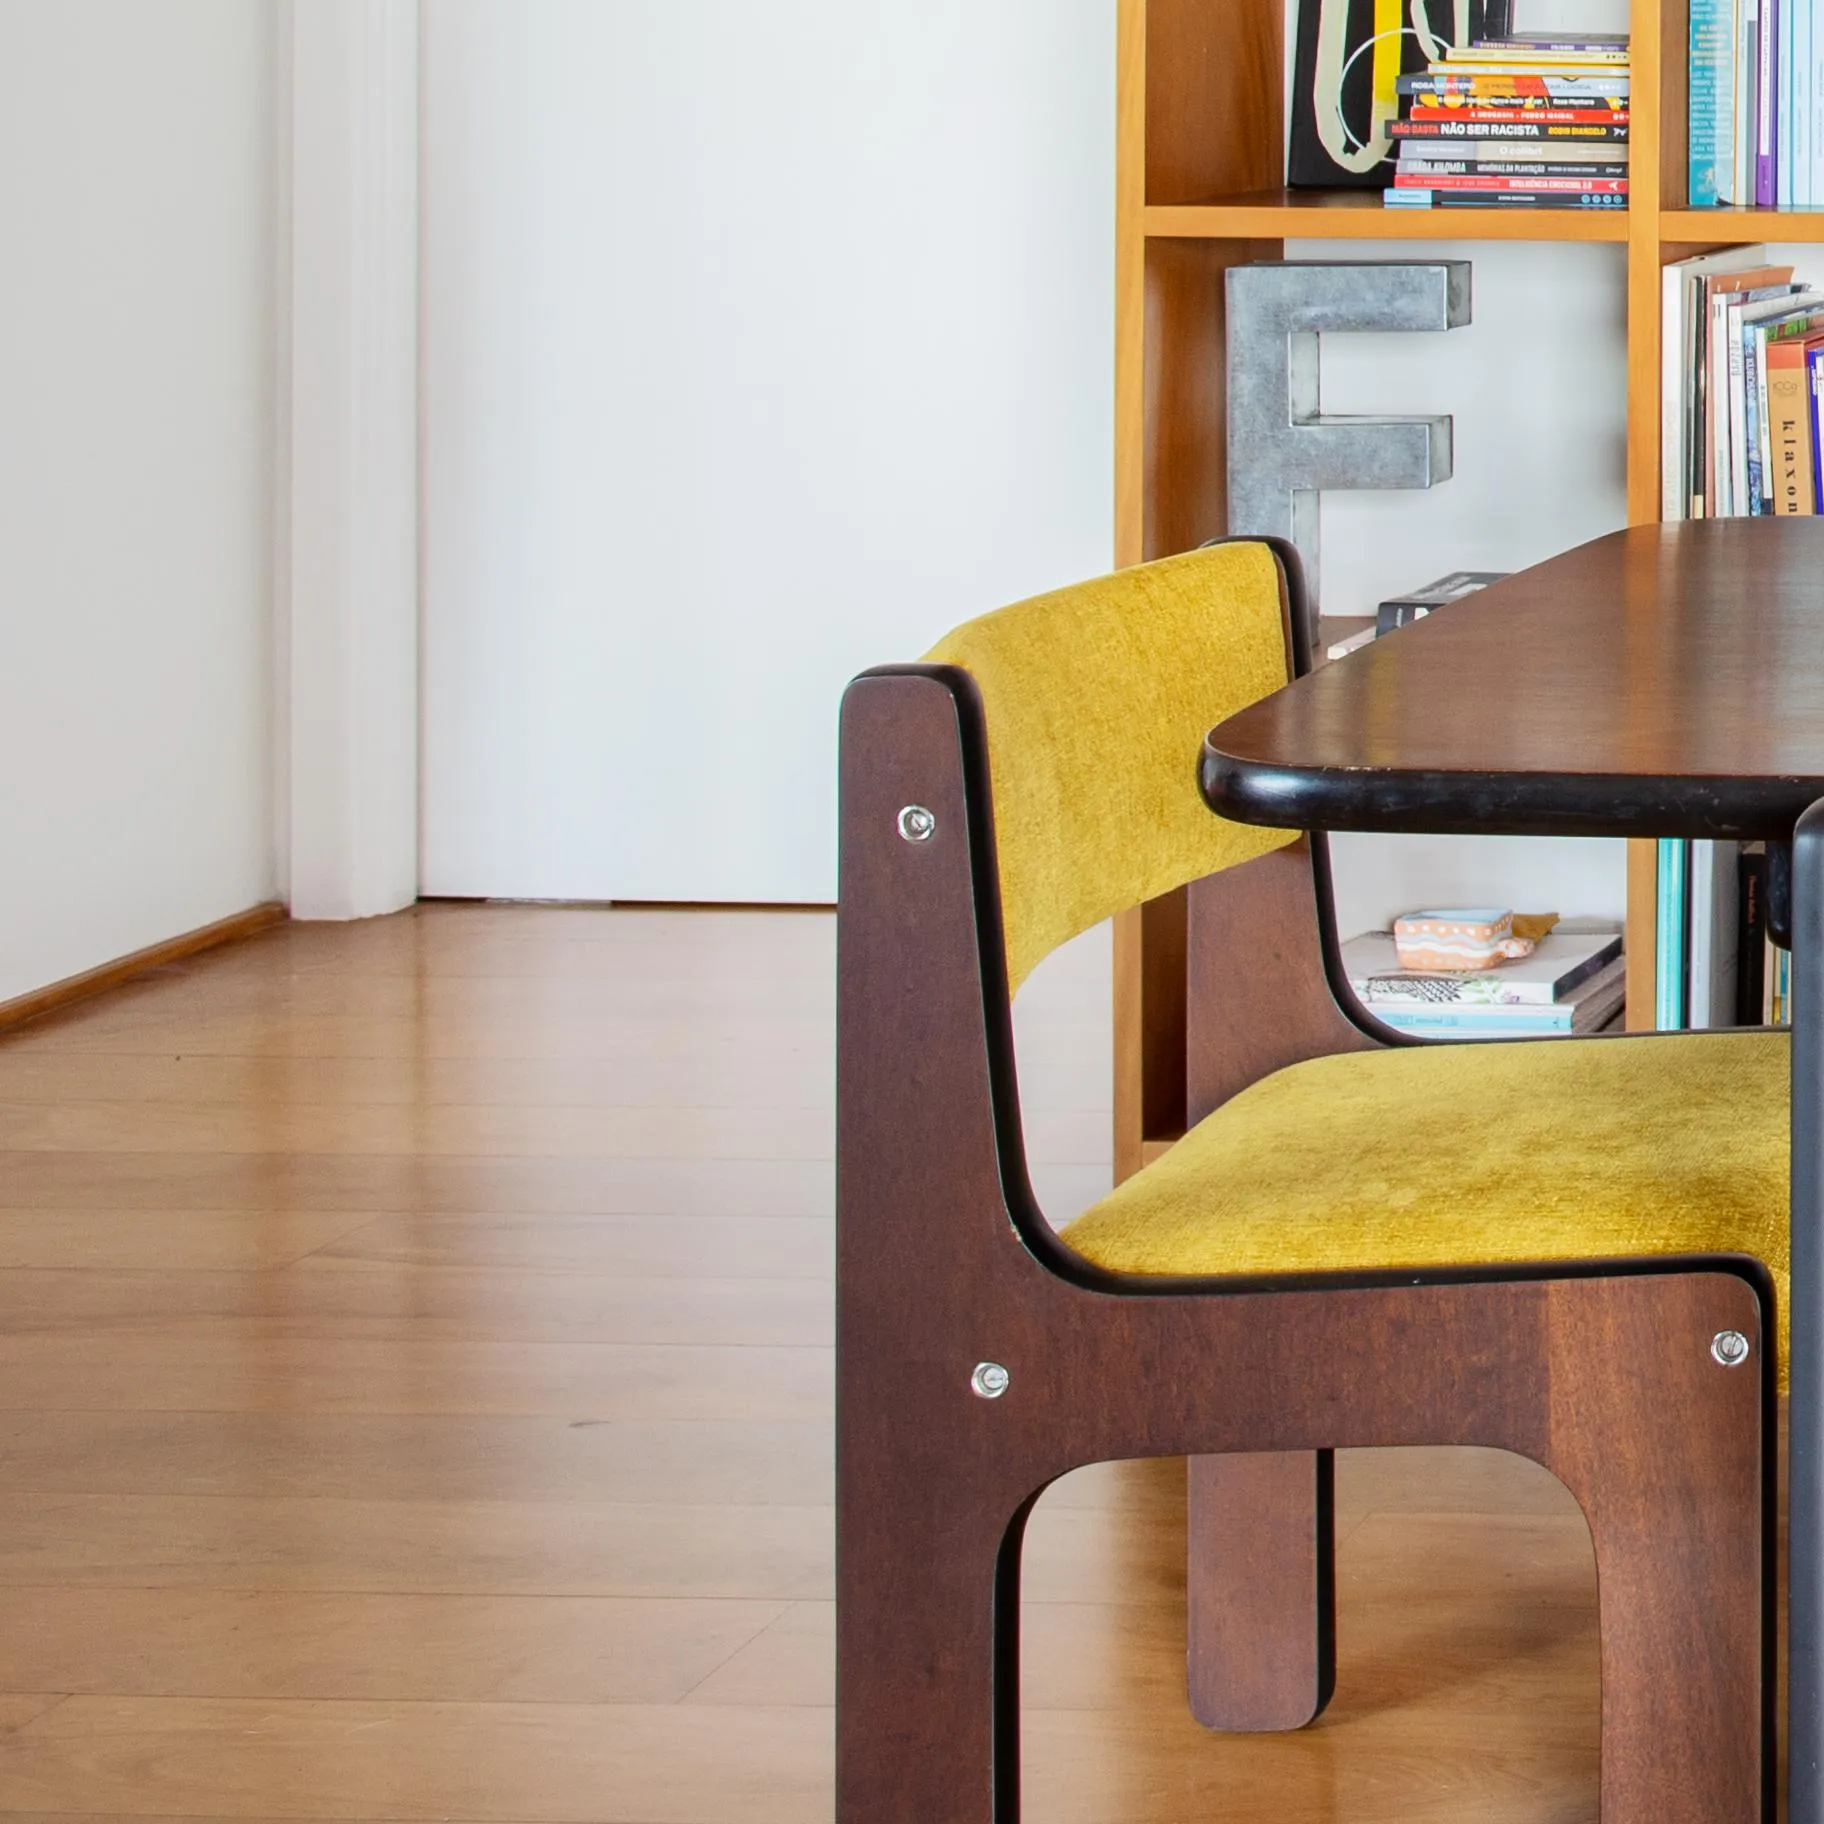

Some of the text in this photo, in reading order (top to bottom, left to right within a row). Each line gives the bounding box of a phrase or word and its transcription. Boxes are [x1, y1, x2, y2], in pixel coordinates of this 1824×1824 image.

[1411, 81, 1476, 90] ROSA MONTERO
[1441, 121, 1540, 136] NÃO SER RACISTA
[1499, 145, 1542, 155] O colibri
[1781, 420, 1798, 514] klaxon
